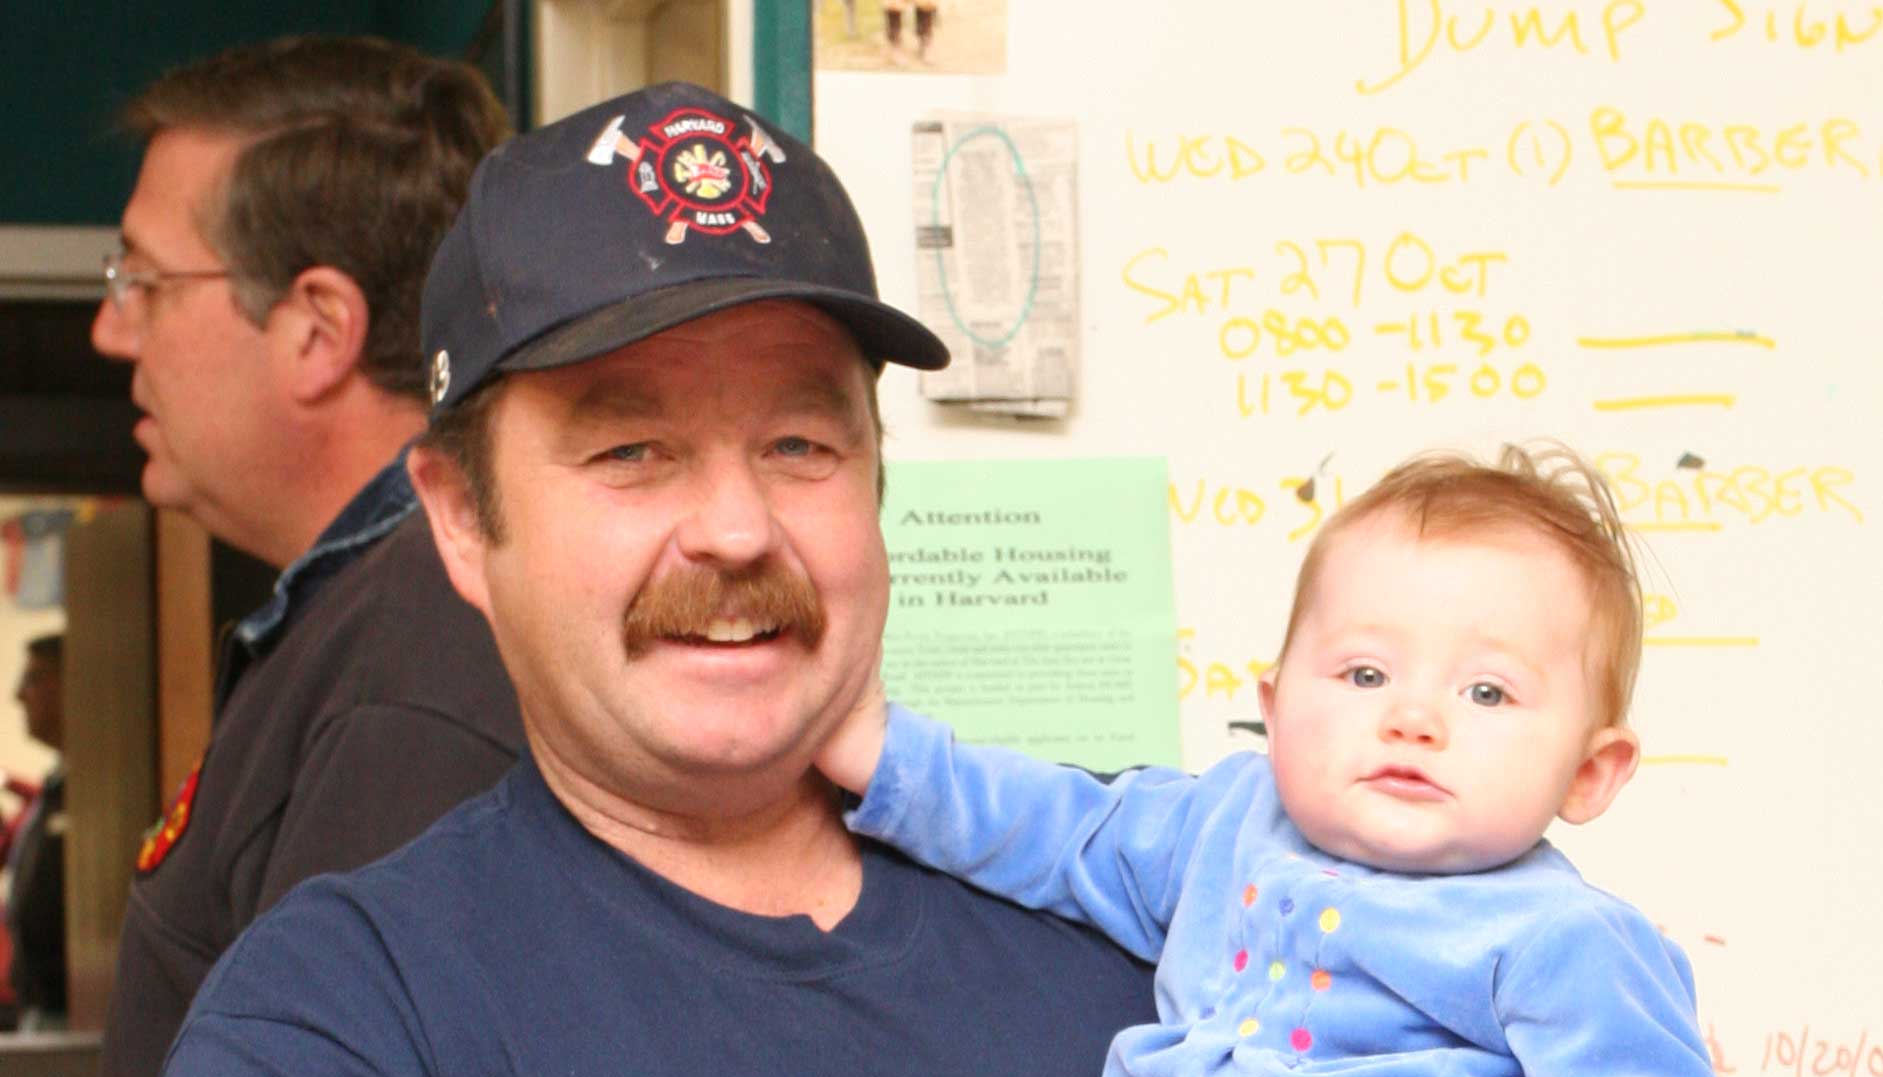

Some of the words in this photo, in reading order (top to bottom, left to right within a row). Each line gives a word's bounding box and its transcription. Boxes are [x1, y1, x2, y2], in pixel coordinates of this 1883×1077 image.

[1590, 105, 1870, 180] BARBER
[695, 211, 736, 225] MASS
[1122, 247, 1255, 325] SAT
[1275, 238, 1367, 309] 27
[1219, 308, 1352, 361] 0800
[1236, 367, 1354, 418] 1130
[900, 508, 1043, 528] Attention
[994, 546, 1113, 565] Housing
[992, 567, 1129, 585] Available
[898, 591, 925, 608] in
[935, 590, 1050, 608] Harvard
